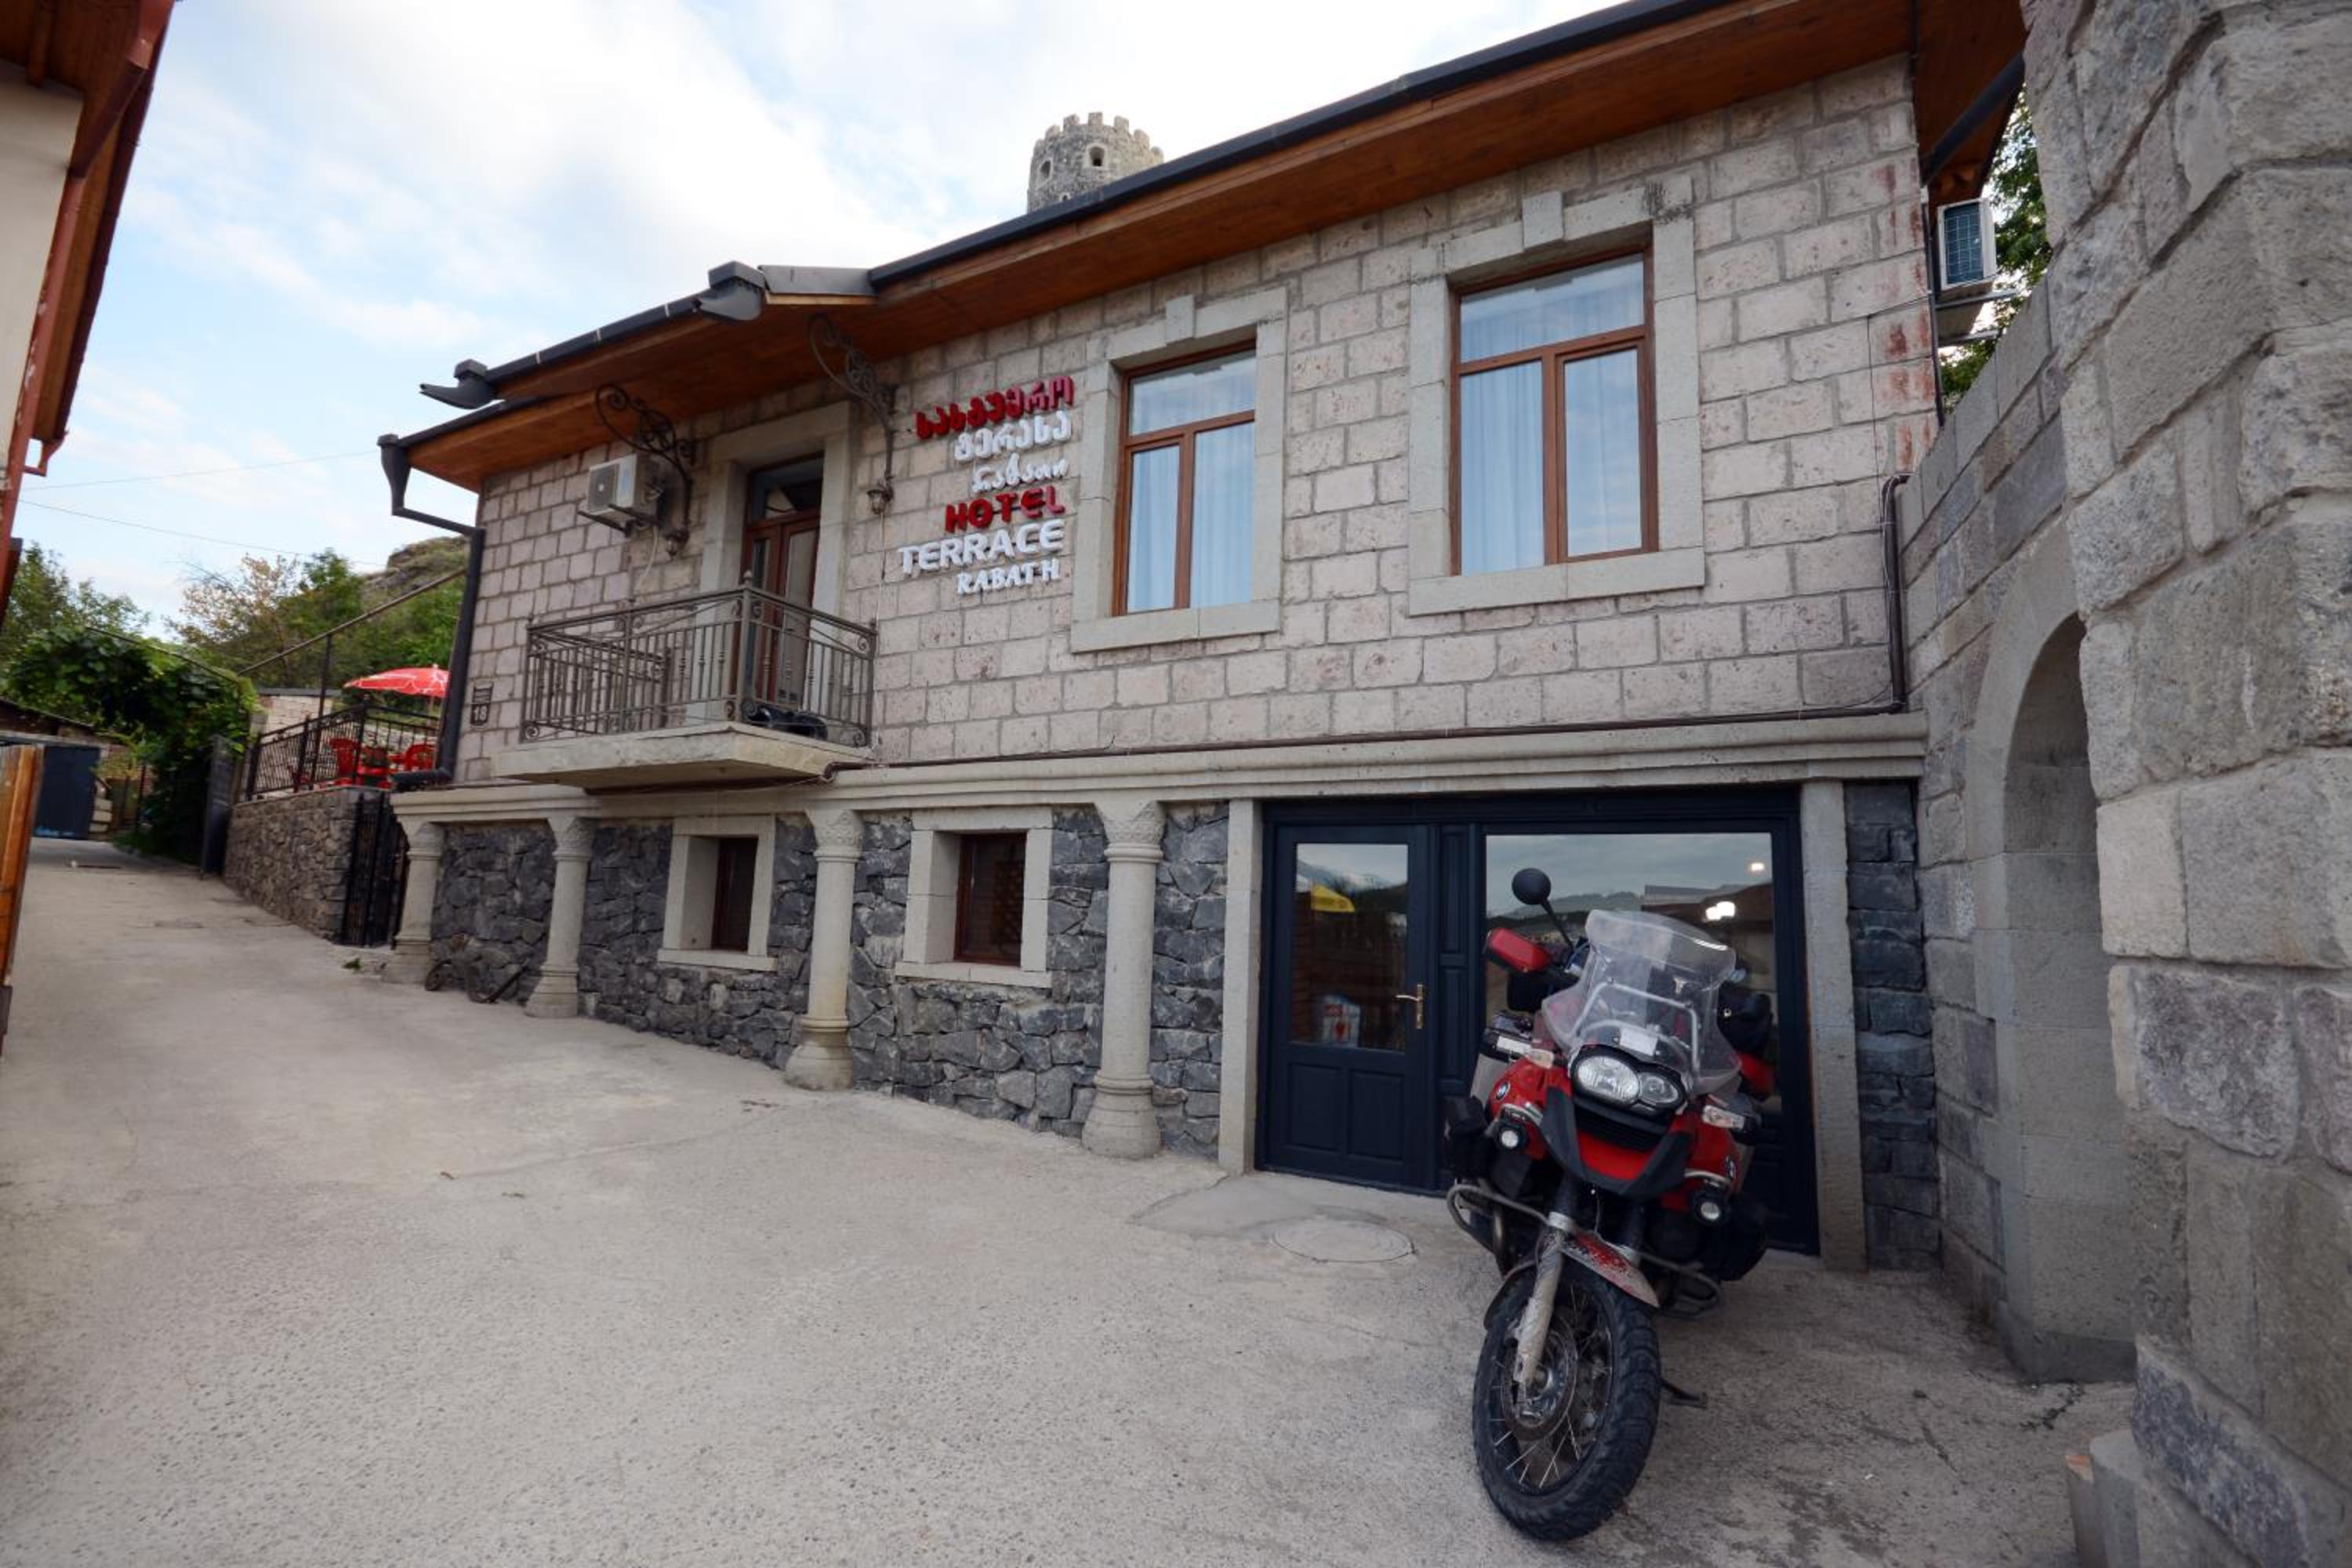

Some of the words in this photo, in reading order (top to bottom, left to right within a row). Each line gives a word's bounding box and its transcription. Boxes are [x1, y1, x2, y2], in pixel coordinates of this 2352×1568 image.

[945, 485, 1065, 533] HOTEL
[899, 519, 1065, 576] TERRACE
[957, 558, 1059, 594] RABATH
